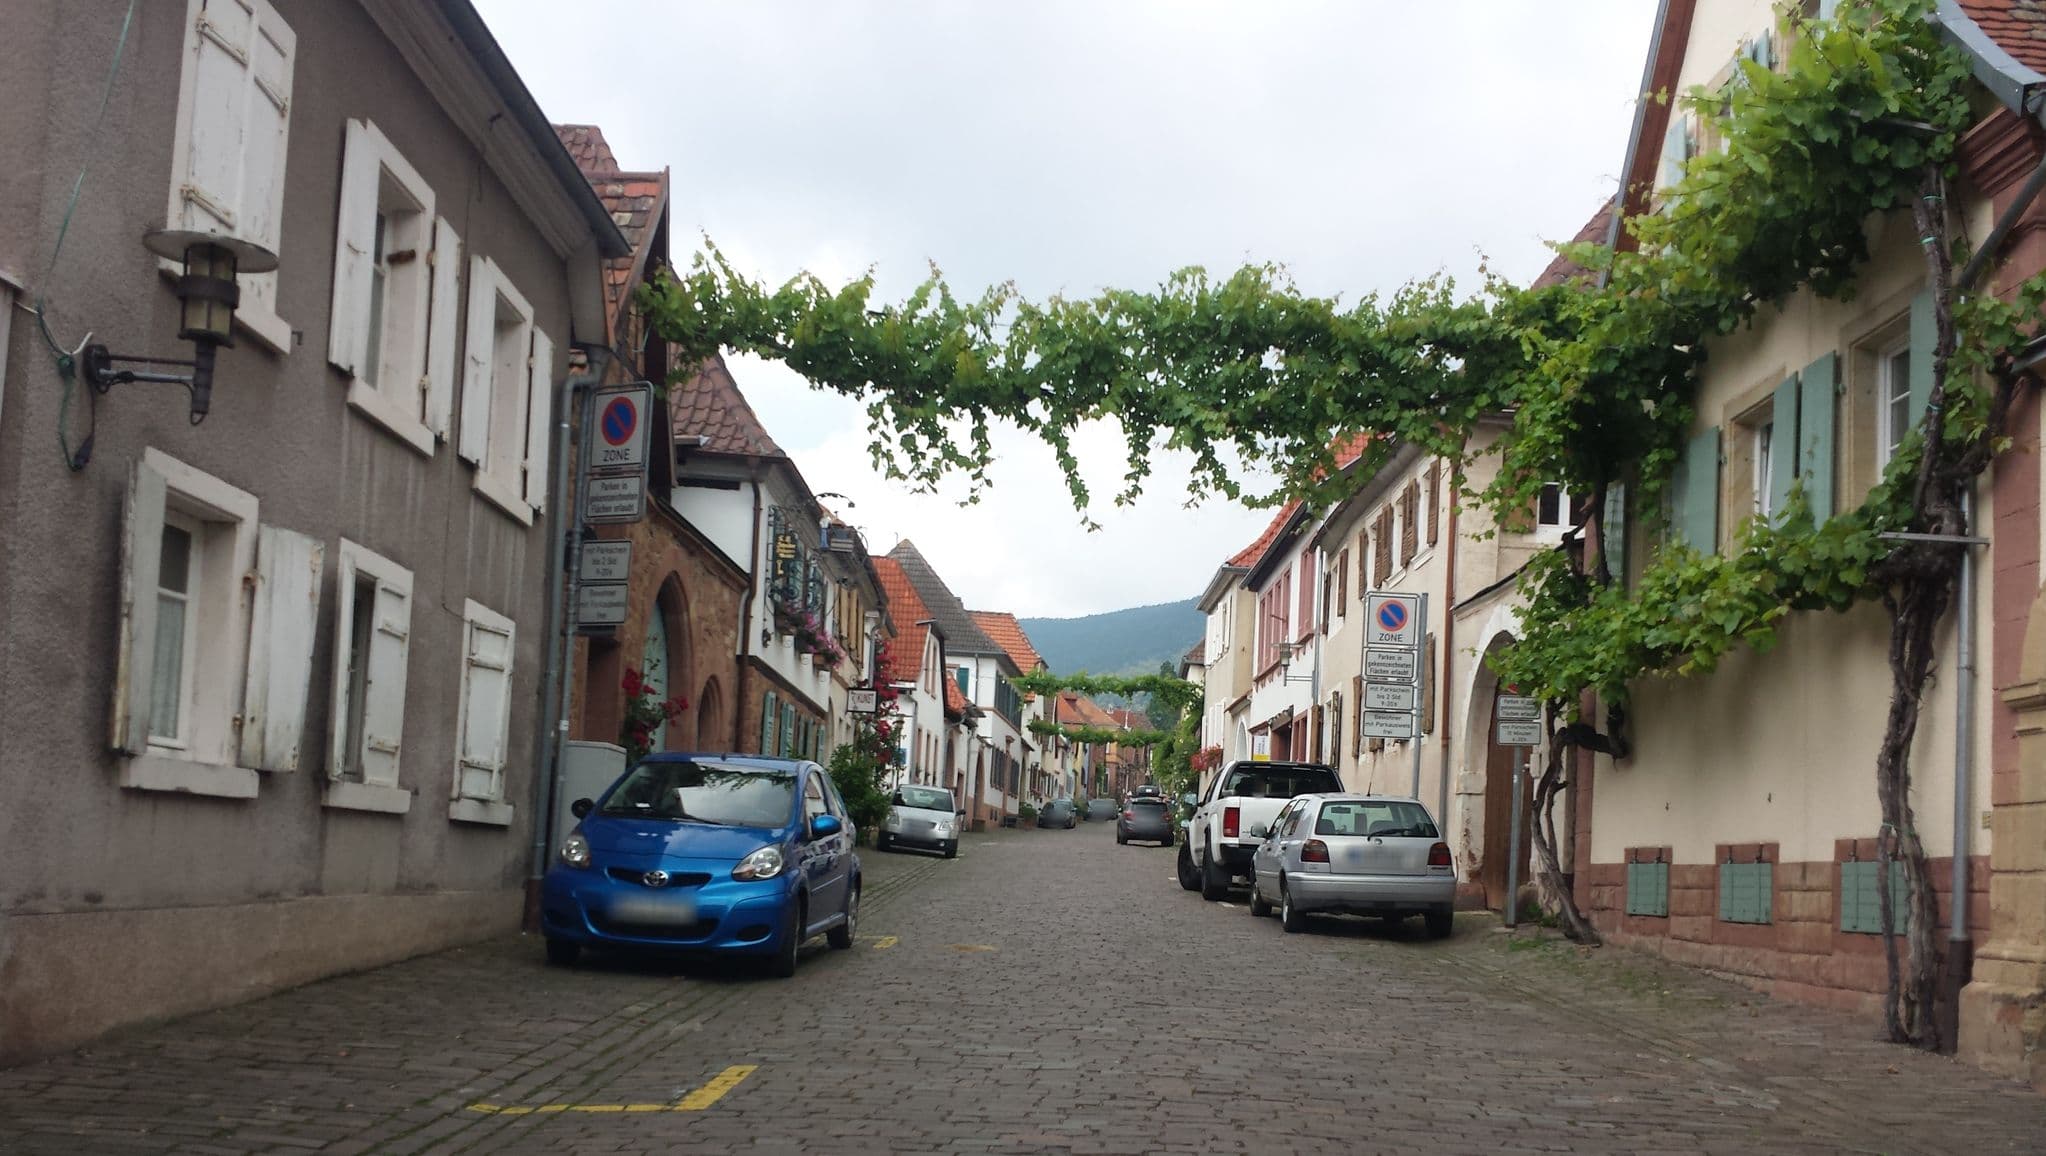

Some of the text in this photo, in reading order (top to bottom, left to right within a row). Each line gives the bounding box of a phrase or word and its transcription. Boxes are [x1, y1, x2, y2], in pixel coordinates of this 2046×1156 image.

[602, 448, 630, 462] ZONE
[1378, 632, 1403, 643] ZONE
[1378, 653, 1396, 661] Parken
